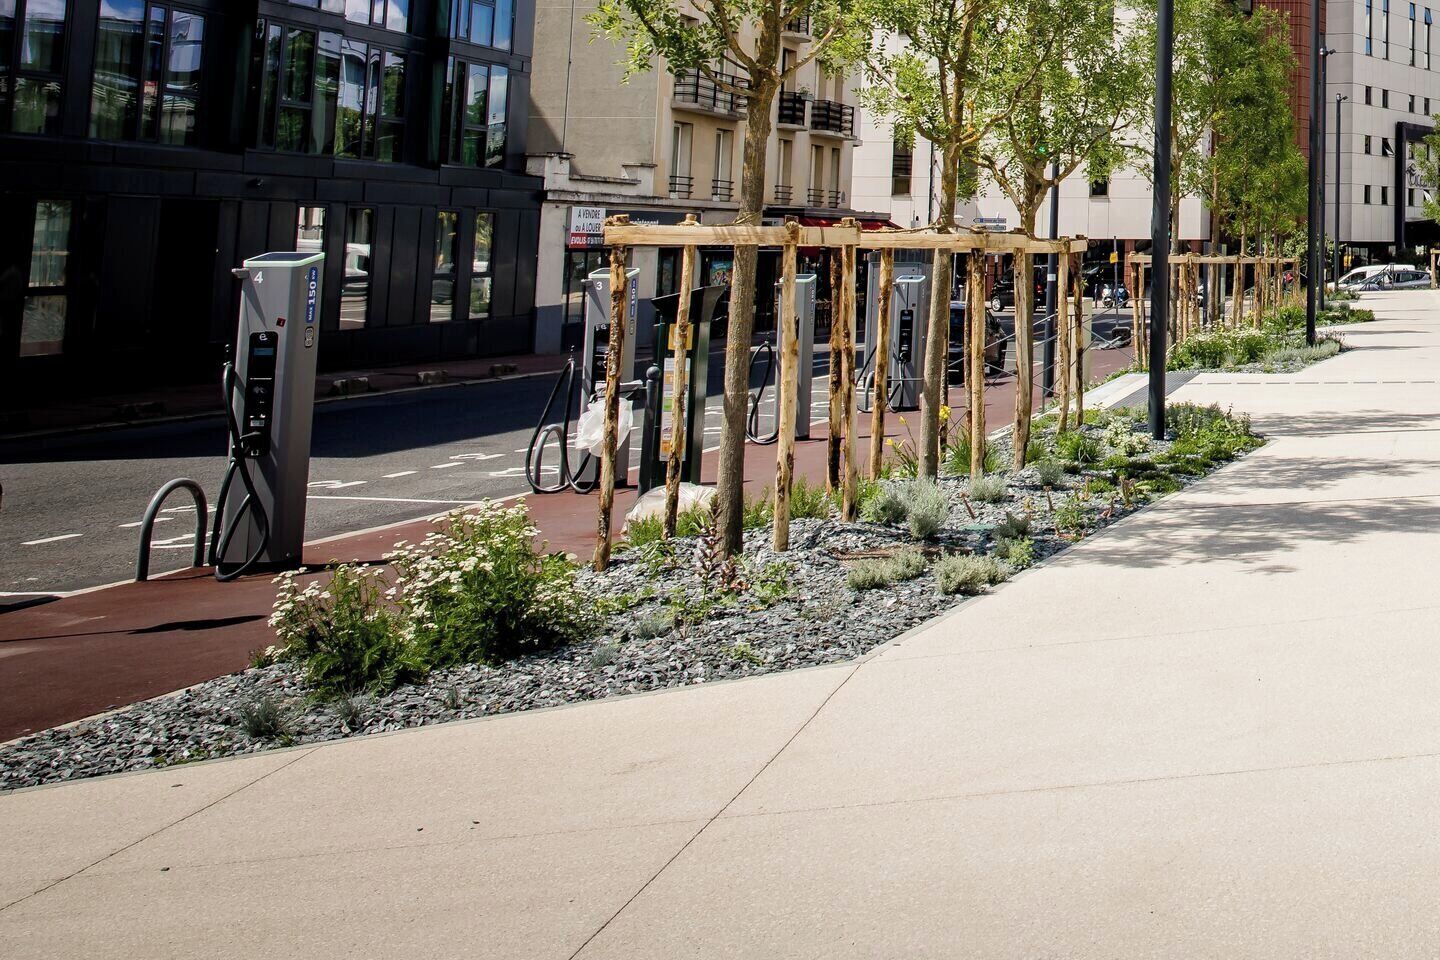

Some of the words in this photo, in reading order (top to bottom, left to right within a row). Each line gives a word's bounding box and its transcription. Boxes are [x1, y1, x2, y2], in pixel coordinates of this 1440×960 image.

[583, 209, 600, 219] VENDRE
[586, 223, 601, 232] LOUER
[570, 236, 587, 245] EVOLIS
[254, 271, 264, 283] 4
[596, 281, 603, 290] 3
[308, 281, 317, 305] 150
